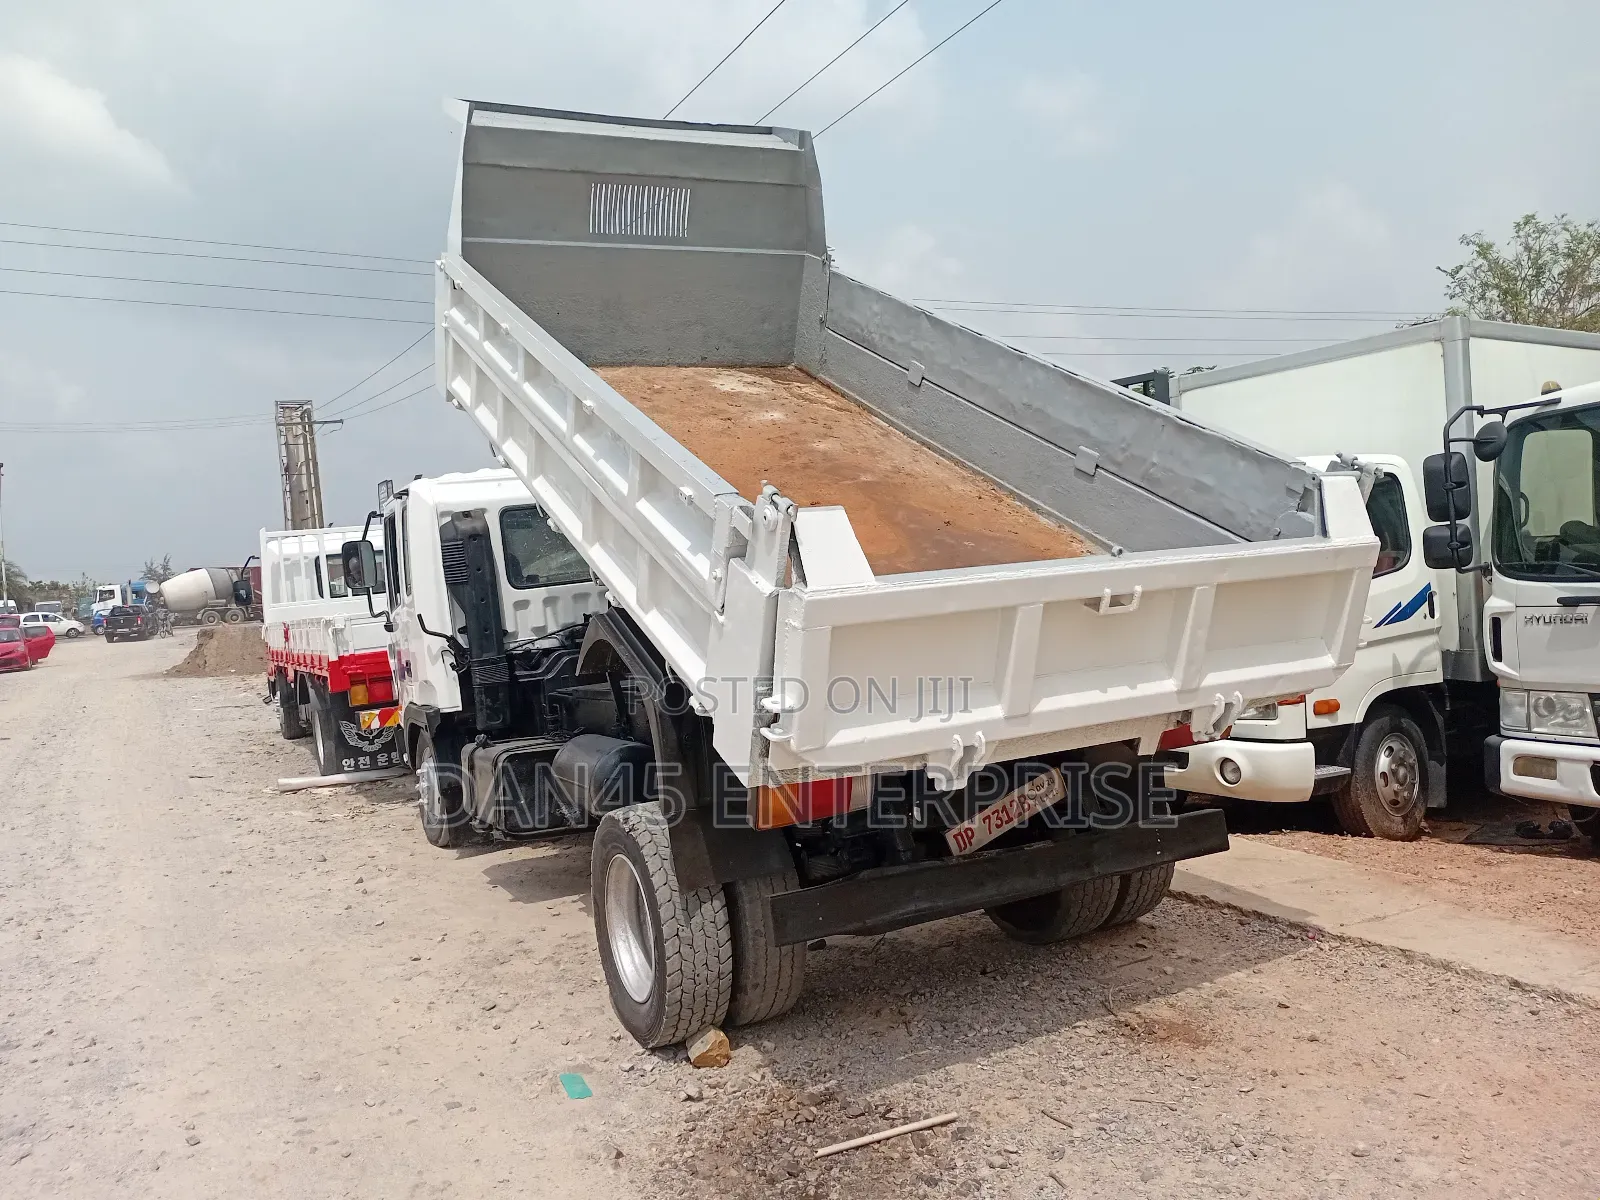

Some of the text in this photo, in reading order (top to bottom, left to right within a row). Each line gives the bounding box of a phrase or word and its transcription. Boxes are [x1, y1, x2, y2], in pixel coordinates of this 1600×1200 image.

[1524, 613, 1589, 625] HYUNDAI
[341, 755, 371, 771] 안전
[952, 827, 975, 853] DP
